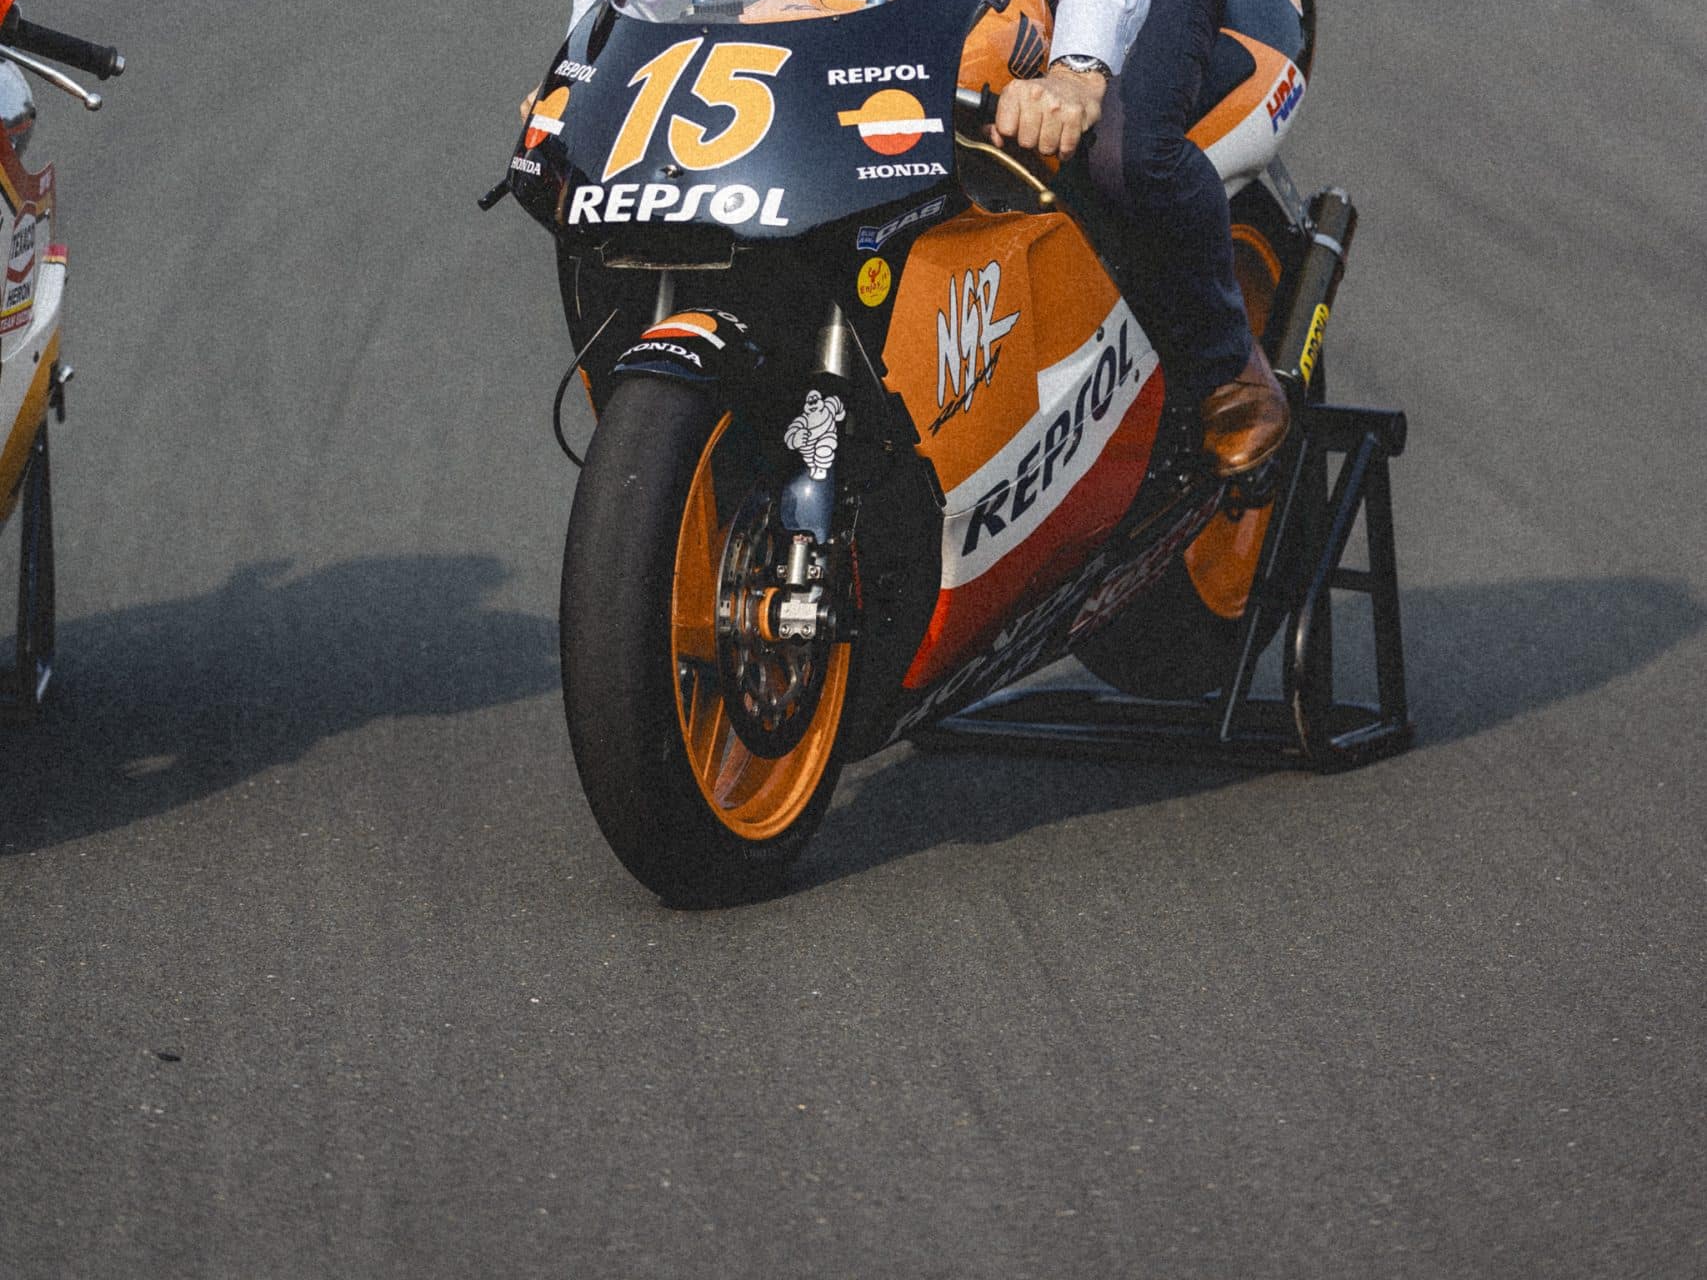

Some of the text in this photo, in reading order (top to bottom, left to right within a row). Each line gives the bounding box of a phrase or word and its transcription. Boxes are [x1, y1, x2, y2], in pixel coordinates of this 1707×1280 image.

[554, 60, 597, 82] REPSOL
[828, 64, 930, 85] REPSOL
[601, 36, 793, 183] 15
[511, 156, 542, 175] HONDA
[856, 162, 948, 180] HONDA
[568, 183, 789, 226] REPSOL
[876, 200, 943, 242] GAS
[937, 260, 1021, 413] NSR
[961, 319, 1133, 558] REPSOL
